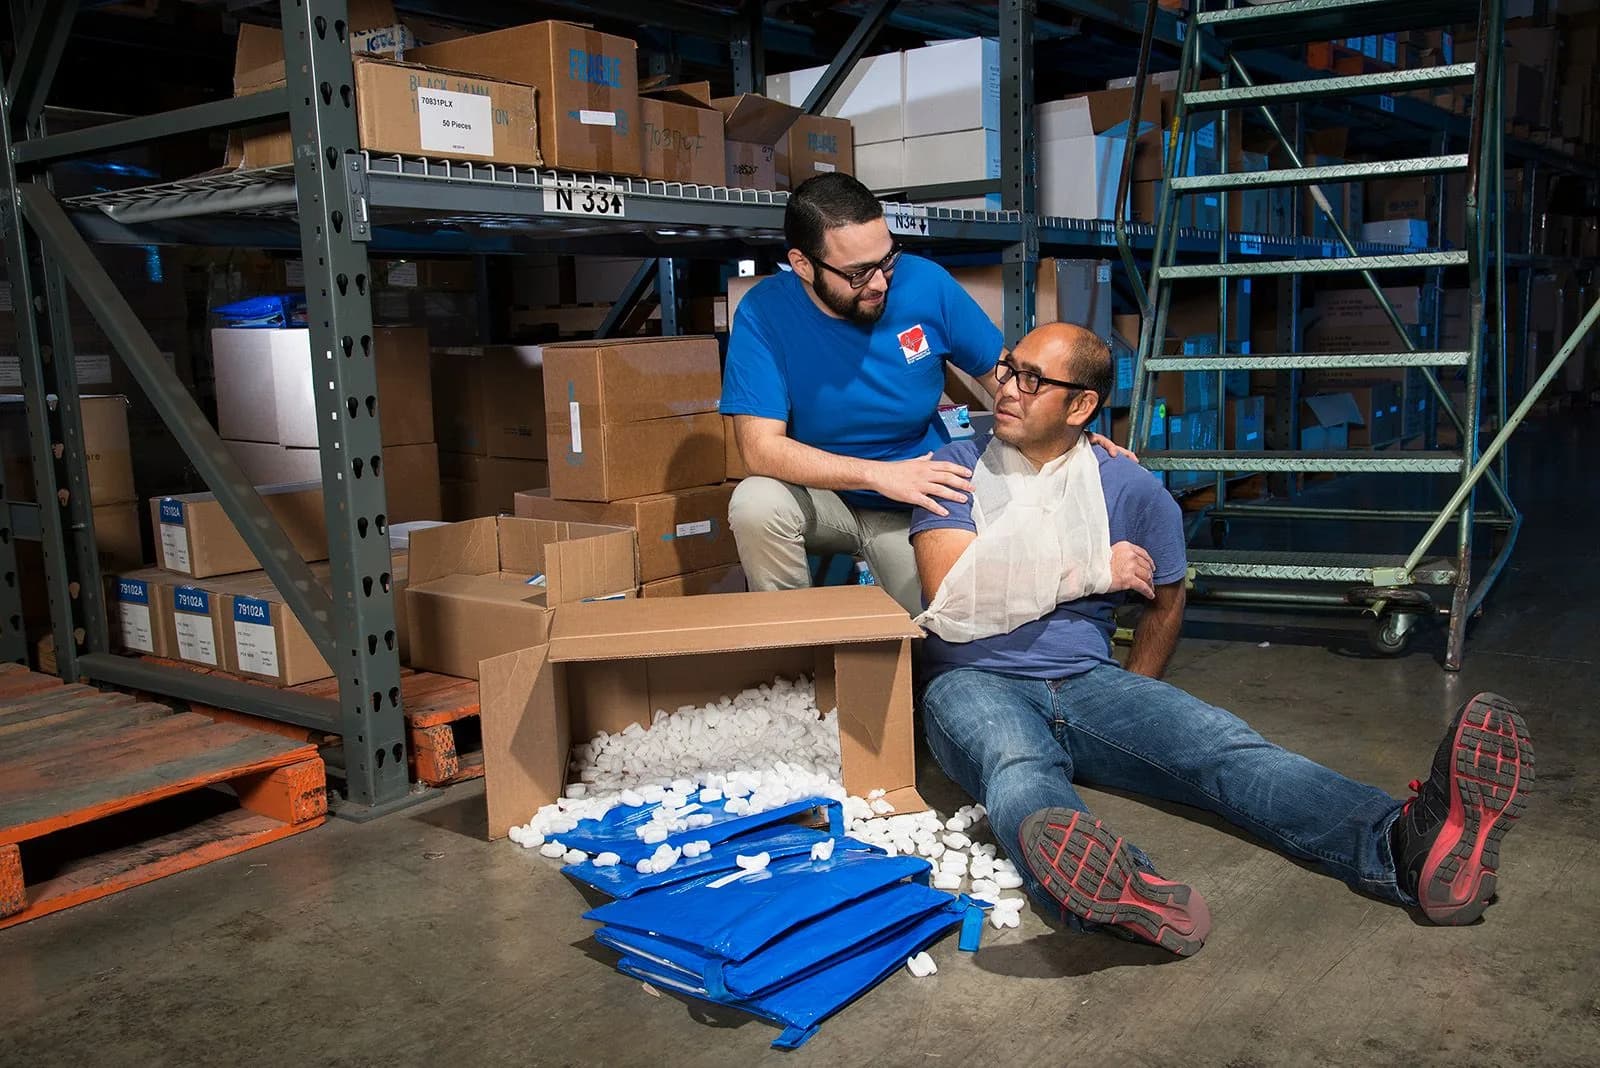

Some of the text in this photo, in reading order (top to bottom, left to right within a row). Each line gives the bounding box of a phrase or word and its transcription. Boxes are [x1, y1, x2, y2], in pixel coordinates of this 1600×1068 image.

[569, 48, 624, 88] FRAGILE
[421, 96, 453, 108] 70831PLX
[442, 119, 472, 131] 50 Pieces
[556, 182, 609, 213] N 33
[895, 212, 916, 230] N34
[120, 583, 144, 597] 79102A
[178, 594, 204, 608] 79102A
[237, 603, 265, 618] 79102A
